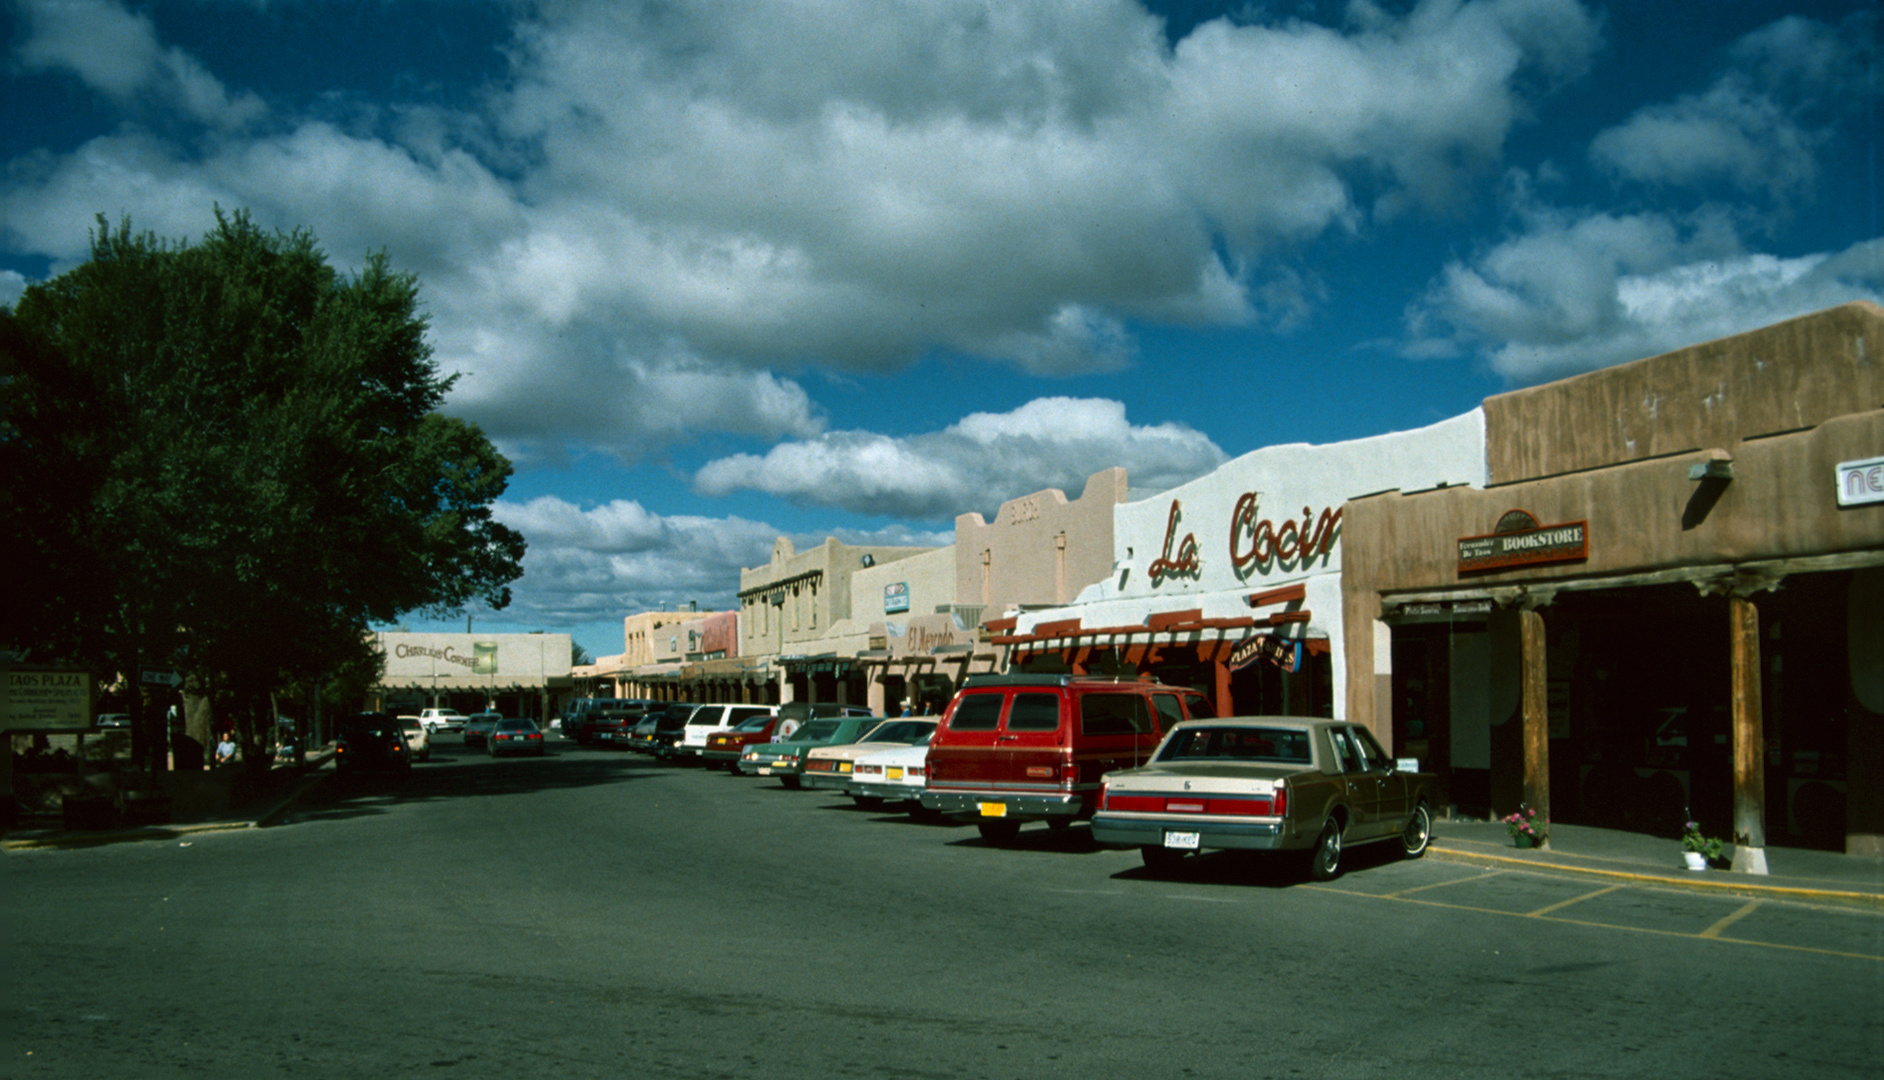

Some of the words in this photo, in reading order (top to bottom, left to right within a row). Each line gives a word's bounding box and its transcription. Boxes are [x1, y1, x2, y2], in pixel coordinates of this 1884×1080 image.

[1148, 499, 1199, 578] La
[1503, 527, 1584, 551] BOOKSTORE
[1474, 549, 1492, 558] Taos
[908, 626, 918, 652] El
[1231, 642, 1258, 663] PLAZA
[9, 675, 39, 686] TAOS
[42, 675, 81, 686] PLAZA
